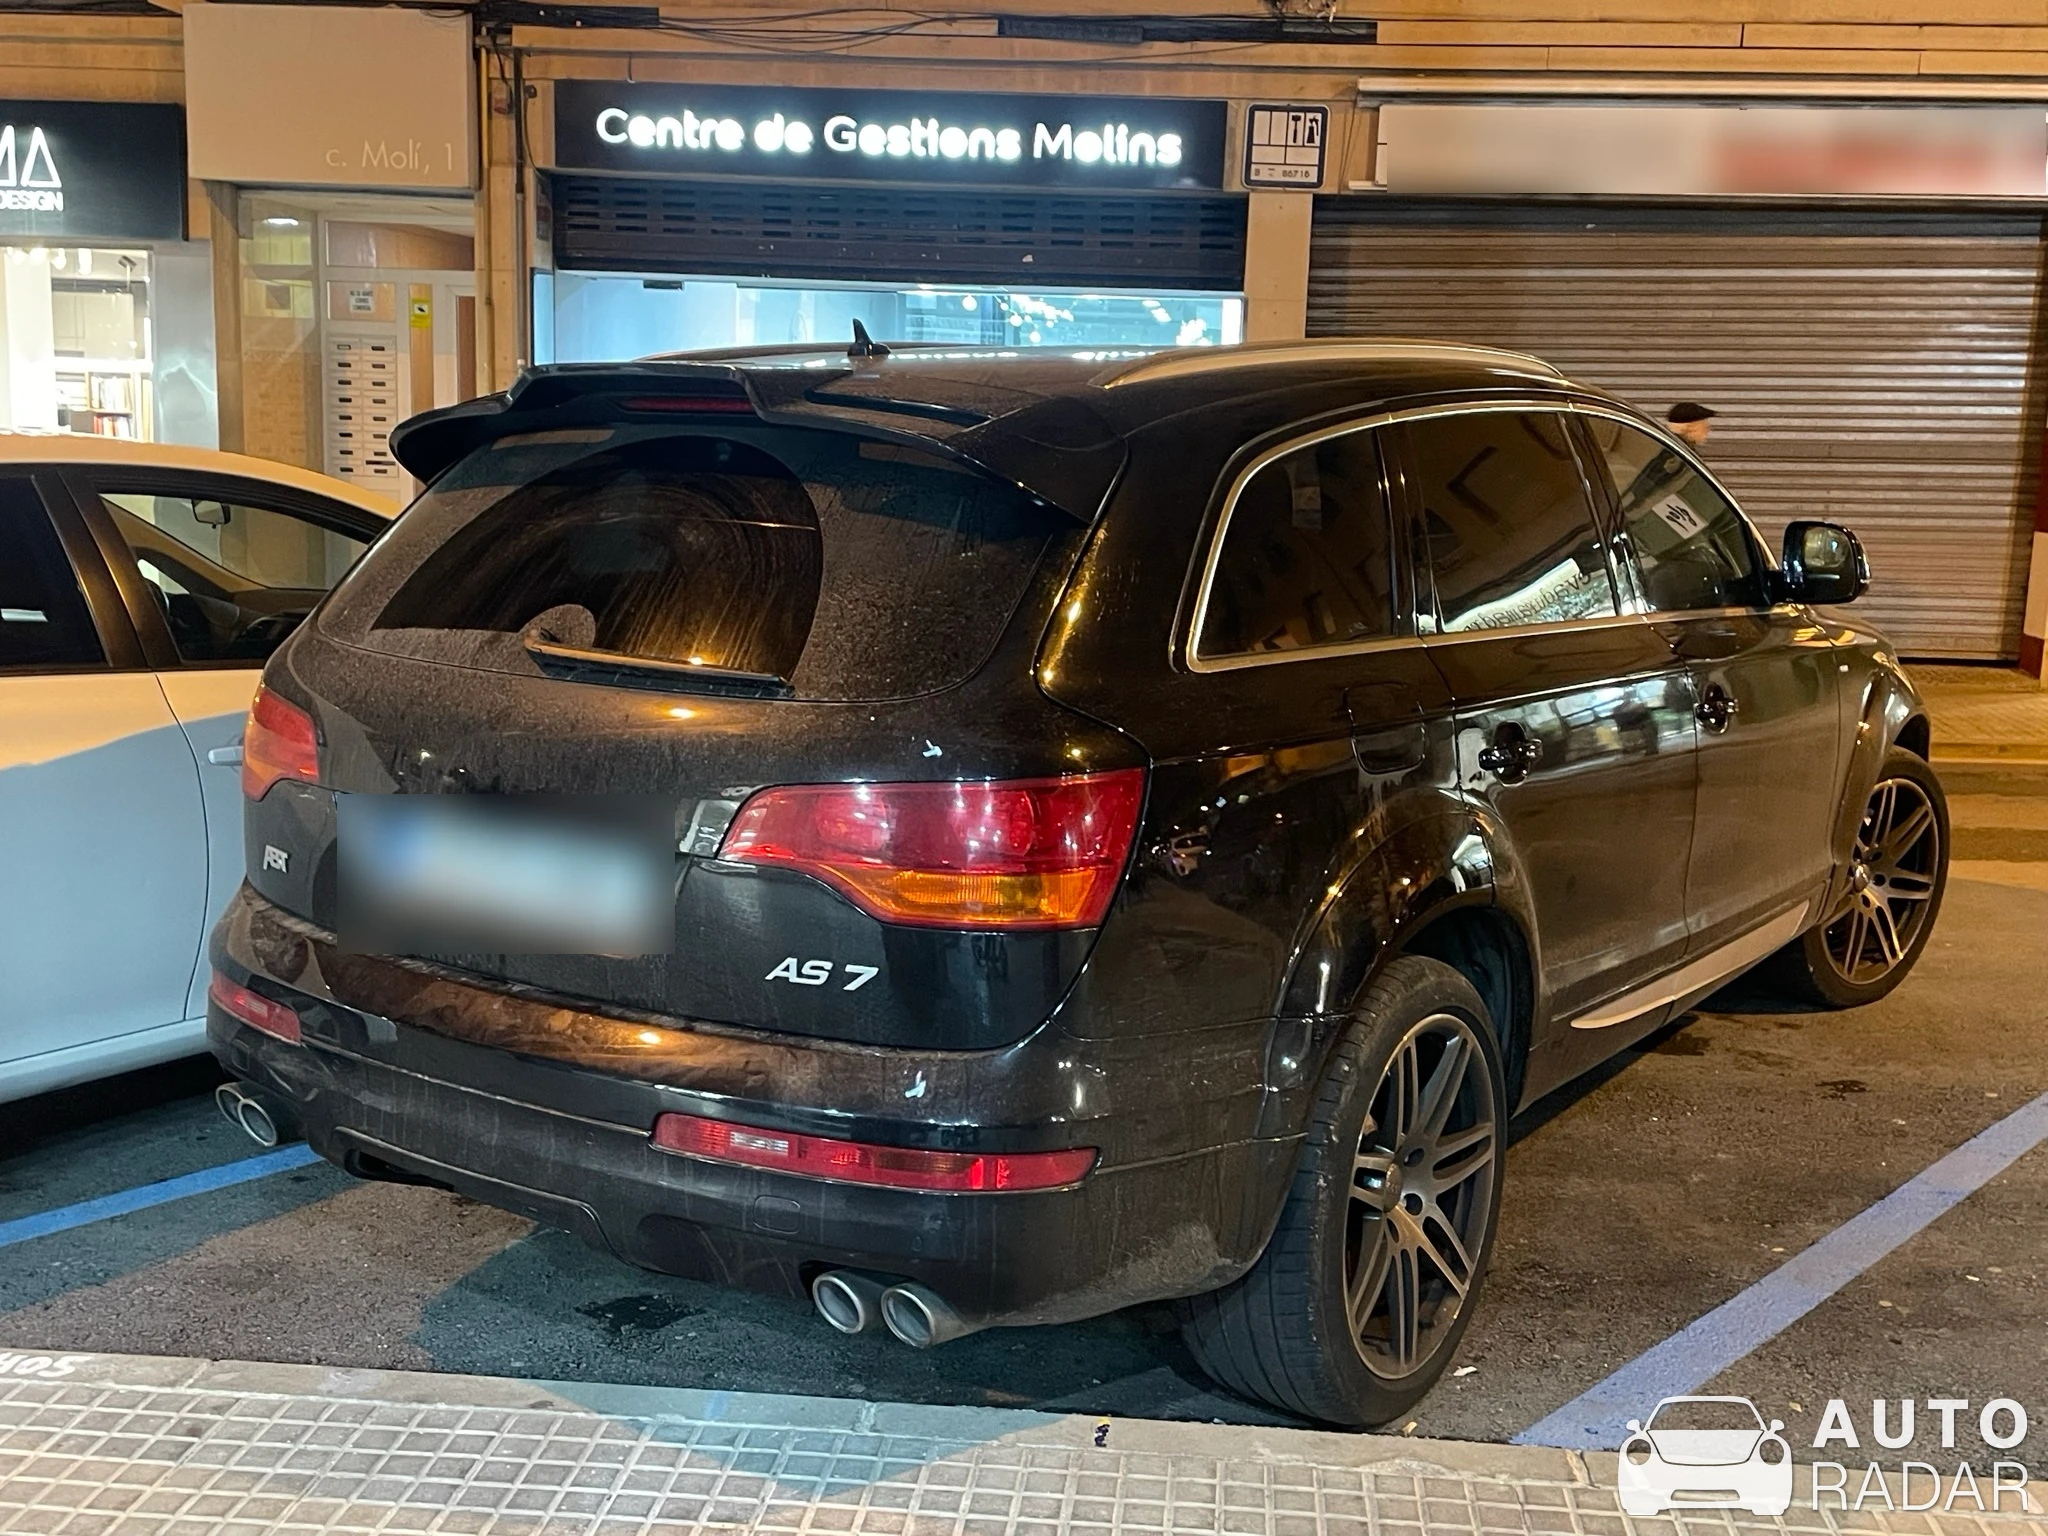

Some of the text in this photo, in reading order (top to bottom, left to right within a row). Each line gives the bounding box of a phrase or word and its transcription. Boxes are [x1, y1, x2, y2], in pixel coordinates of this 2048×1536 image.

[596, 107, 1182, 165] Centre de Gestions Molins
[325, 148, 347, 167] c.
[444, 142, 452, 171] 1
[263, 844, 288, 874] ABT
[764, 957, 880, 991] AS 7
